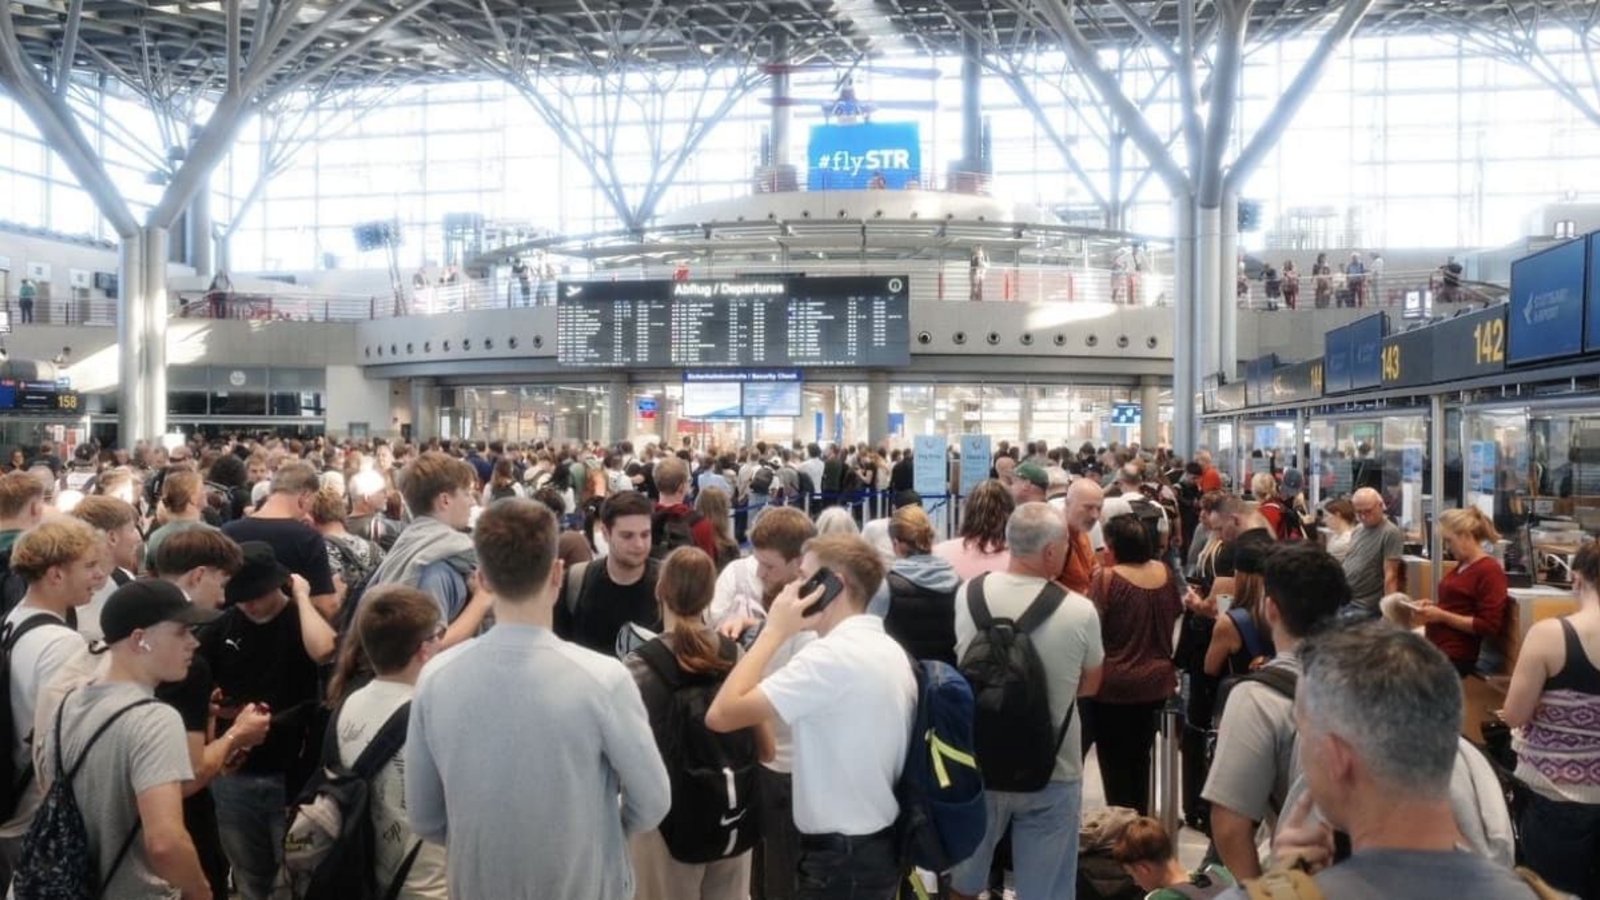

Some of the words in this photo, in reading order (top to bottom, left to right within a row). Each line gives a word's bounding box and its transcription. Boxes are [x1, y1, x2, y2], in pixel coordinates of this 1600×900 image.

[818, 149, 910, 176] #flySTR
[674, 284, 712, 298] Abflug
[713, 283, 720, 296] /
[721, 283, 784, 296] Departures
[1474, 318, 1504, 365] 142
[1381, 345, 1399, 381] 143
[58, 395, 77, 408] 158
